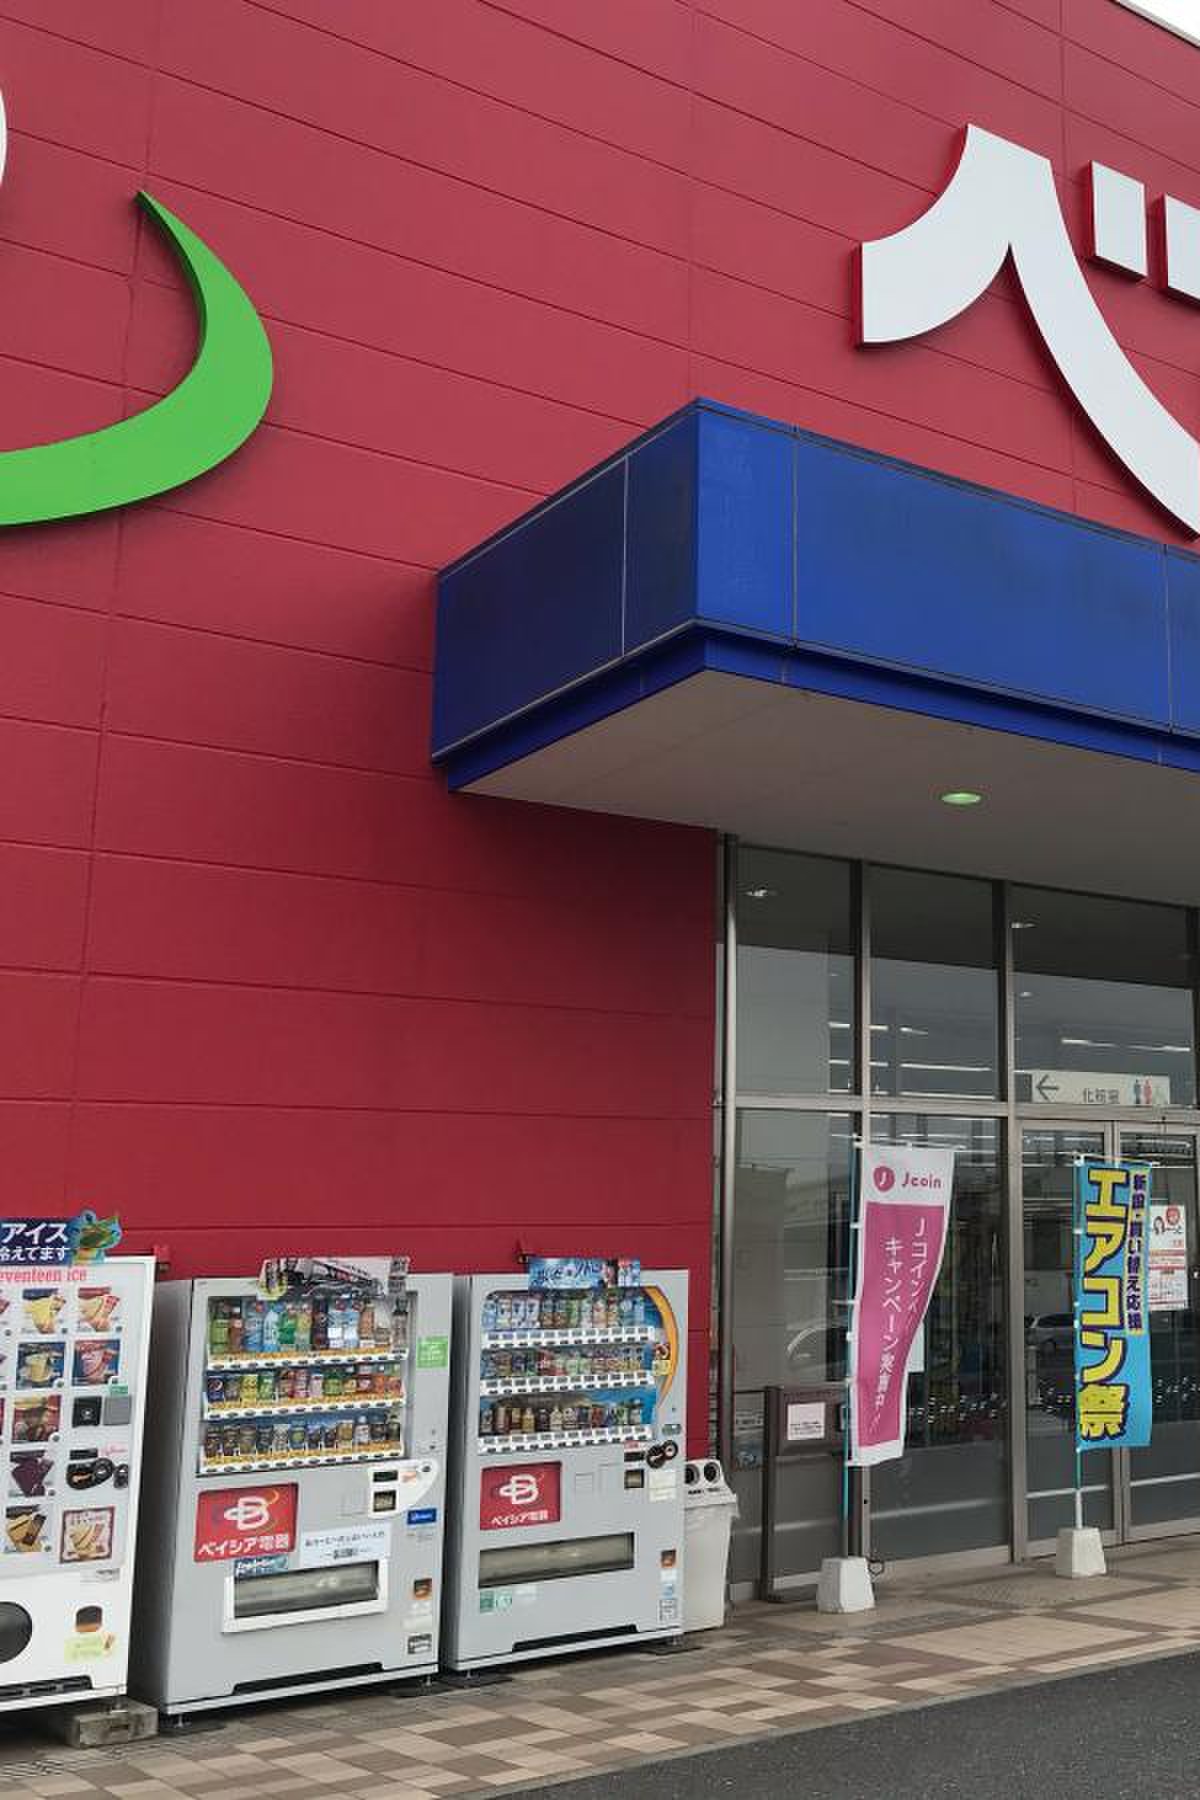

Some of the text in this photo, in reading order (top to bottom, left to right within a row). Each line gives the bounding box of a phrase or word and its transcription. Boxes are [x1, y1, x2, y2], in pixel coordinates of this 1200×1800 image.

[1, 1221, 69, 1244] アイス
[1080, 1169, 1128, 1437] エアコン祭
[198, 1534, 288, 1556] ベイシア電器
